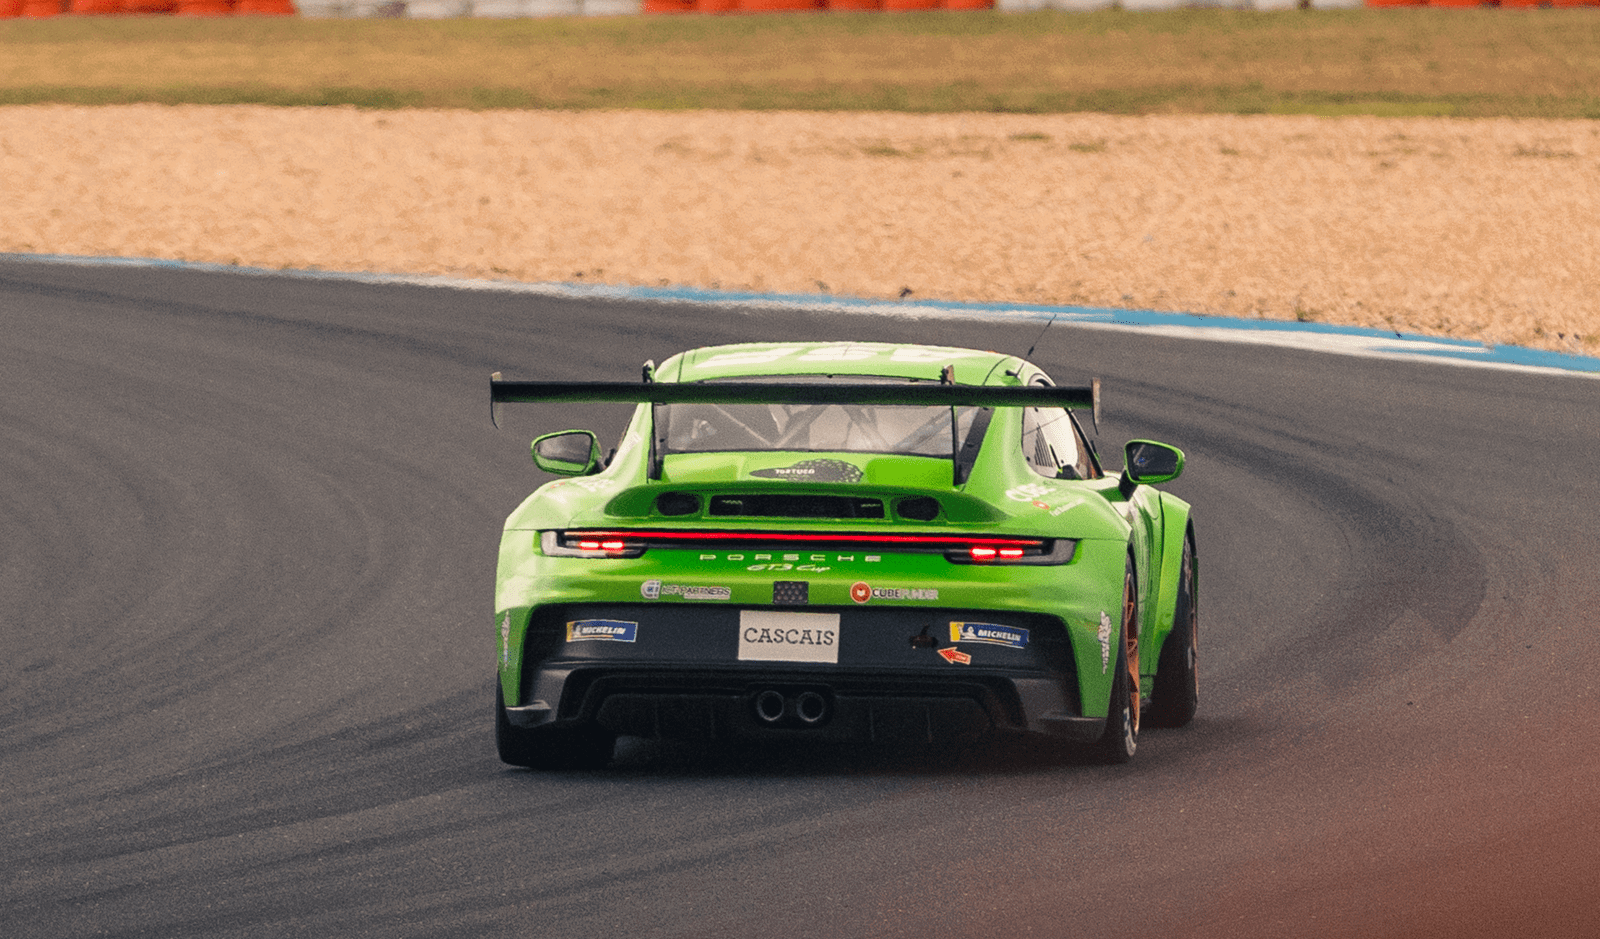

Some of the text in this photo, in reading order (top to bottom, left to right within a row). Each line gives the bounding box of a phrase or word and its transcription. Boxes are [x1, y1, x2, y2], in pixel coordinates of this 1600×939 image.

[700, 553, 881, 562] PORSCHE
[746, 563, 831, 573] GT3 Cup
[581, 625, 627, 635] MICHELIN
[743, 627, 835, 646] CASCAIS
[977, 629, 1022, 642] MICHELIN
